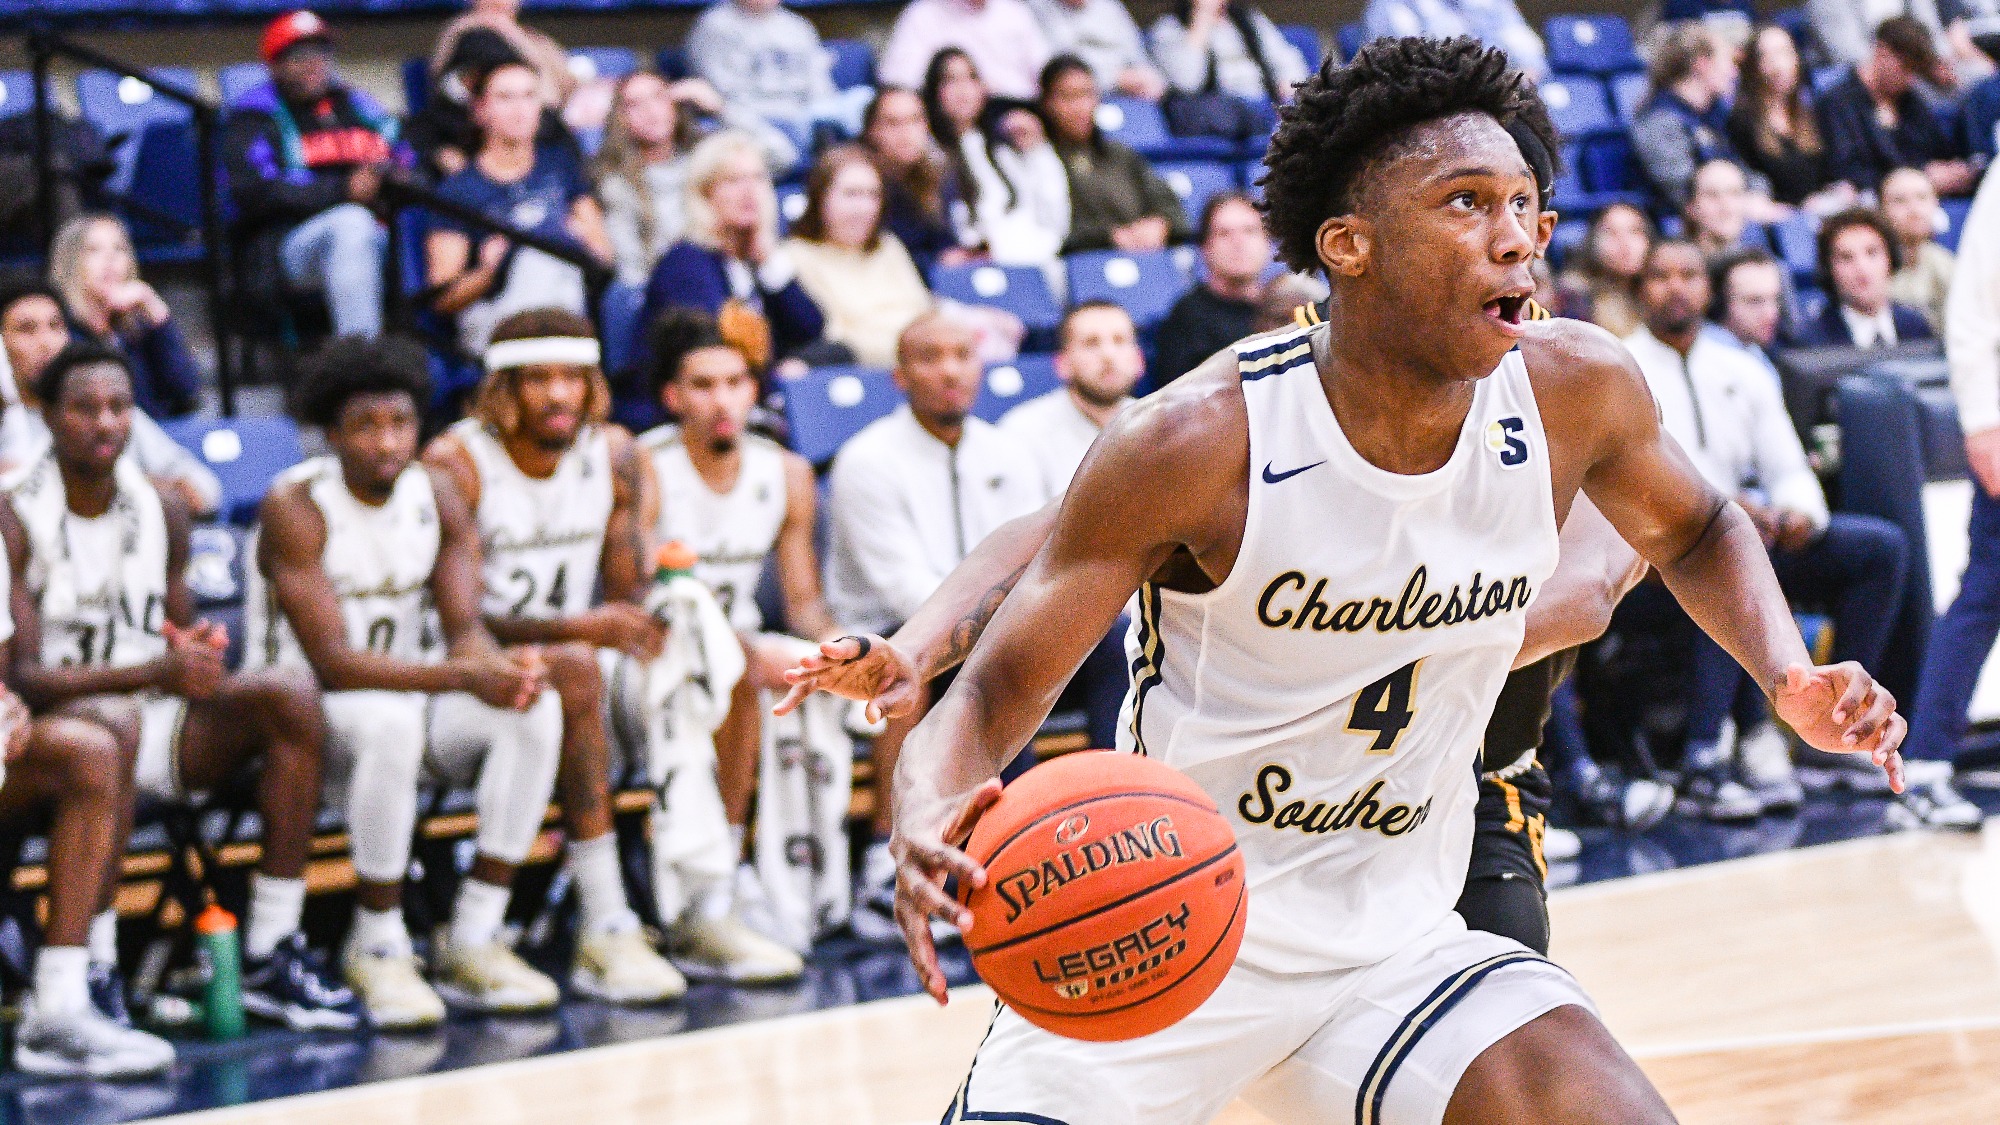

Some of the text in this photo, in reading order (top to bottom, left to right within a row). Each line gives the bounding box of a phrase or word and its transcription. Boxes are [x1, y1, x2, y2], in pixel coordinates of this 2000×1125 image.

[1256, 565, 1532, 634] Charleston
[1342, 655, 1427, 757] 4
[1237, 762, 1434, 837] Southe
[995, 815, 1185, 925] SPALDING
[1031, 902, 1193, 985] LEGACY
[1094, 938, 1189, 991] 1000
